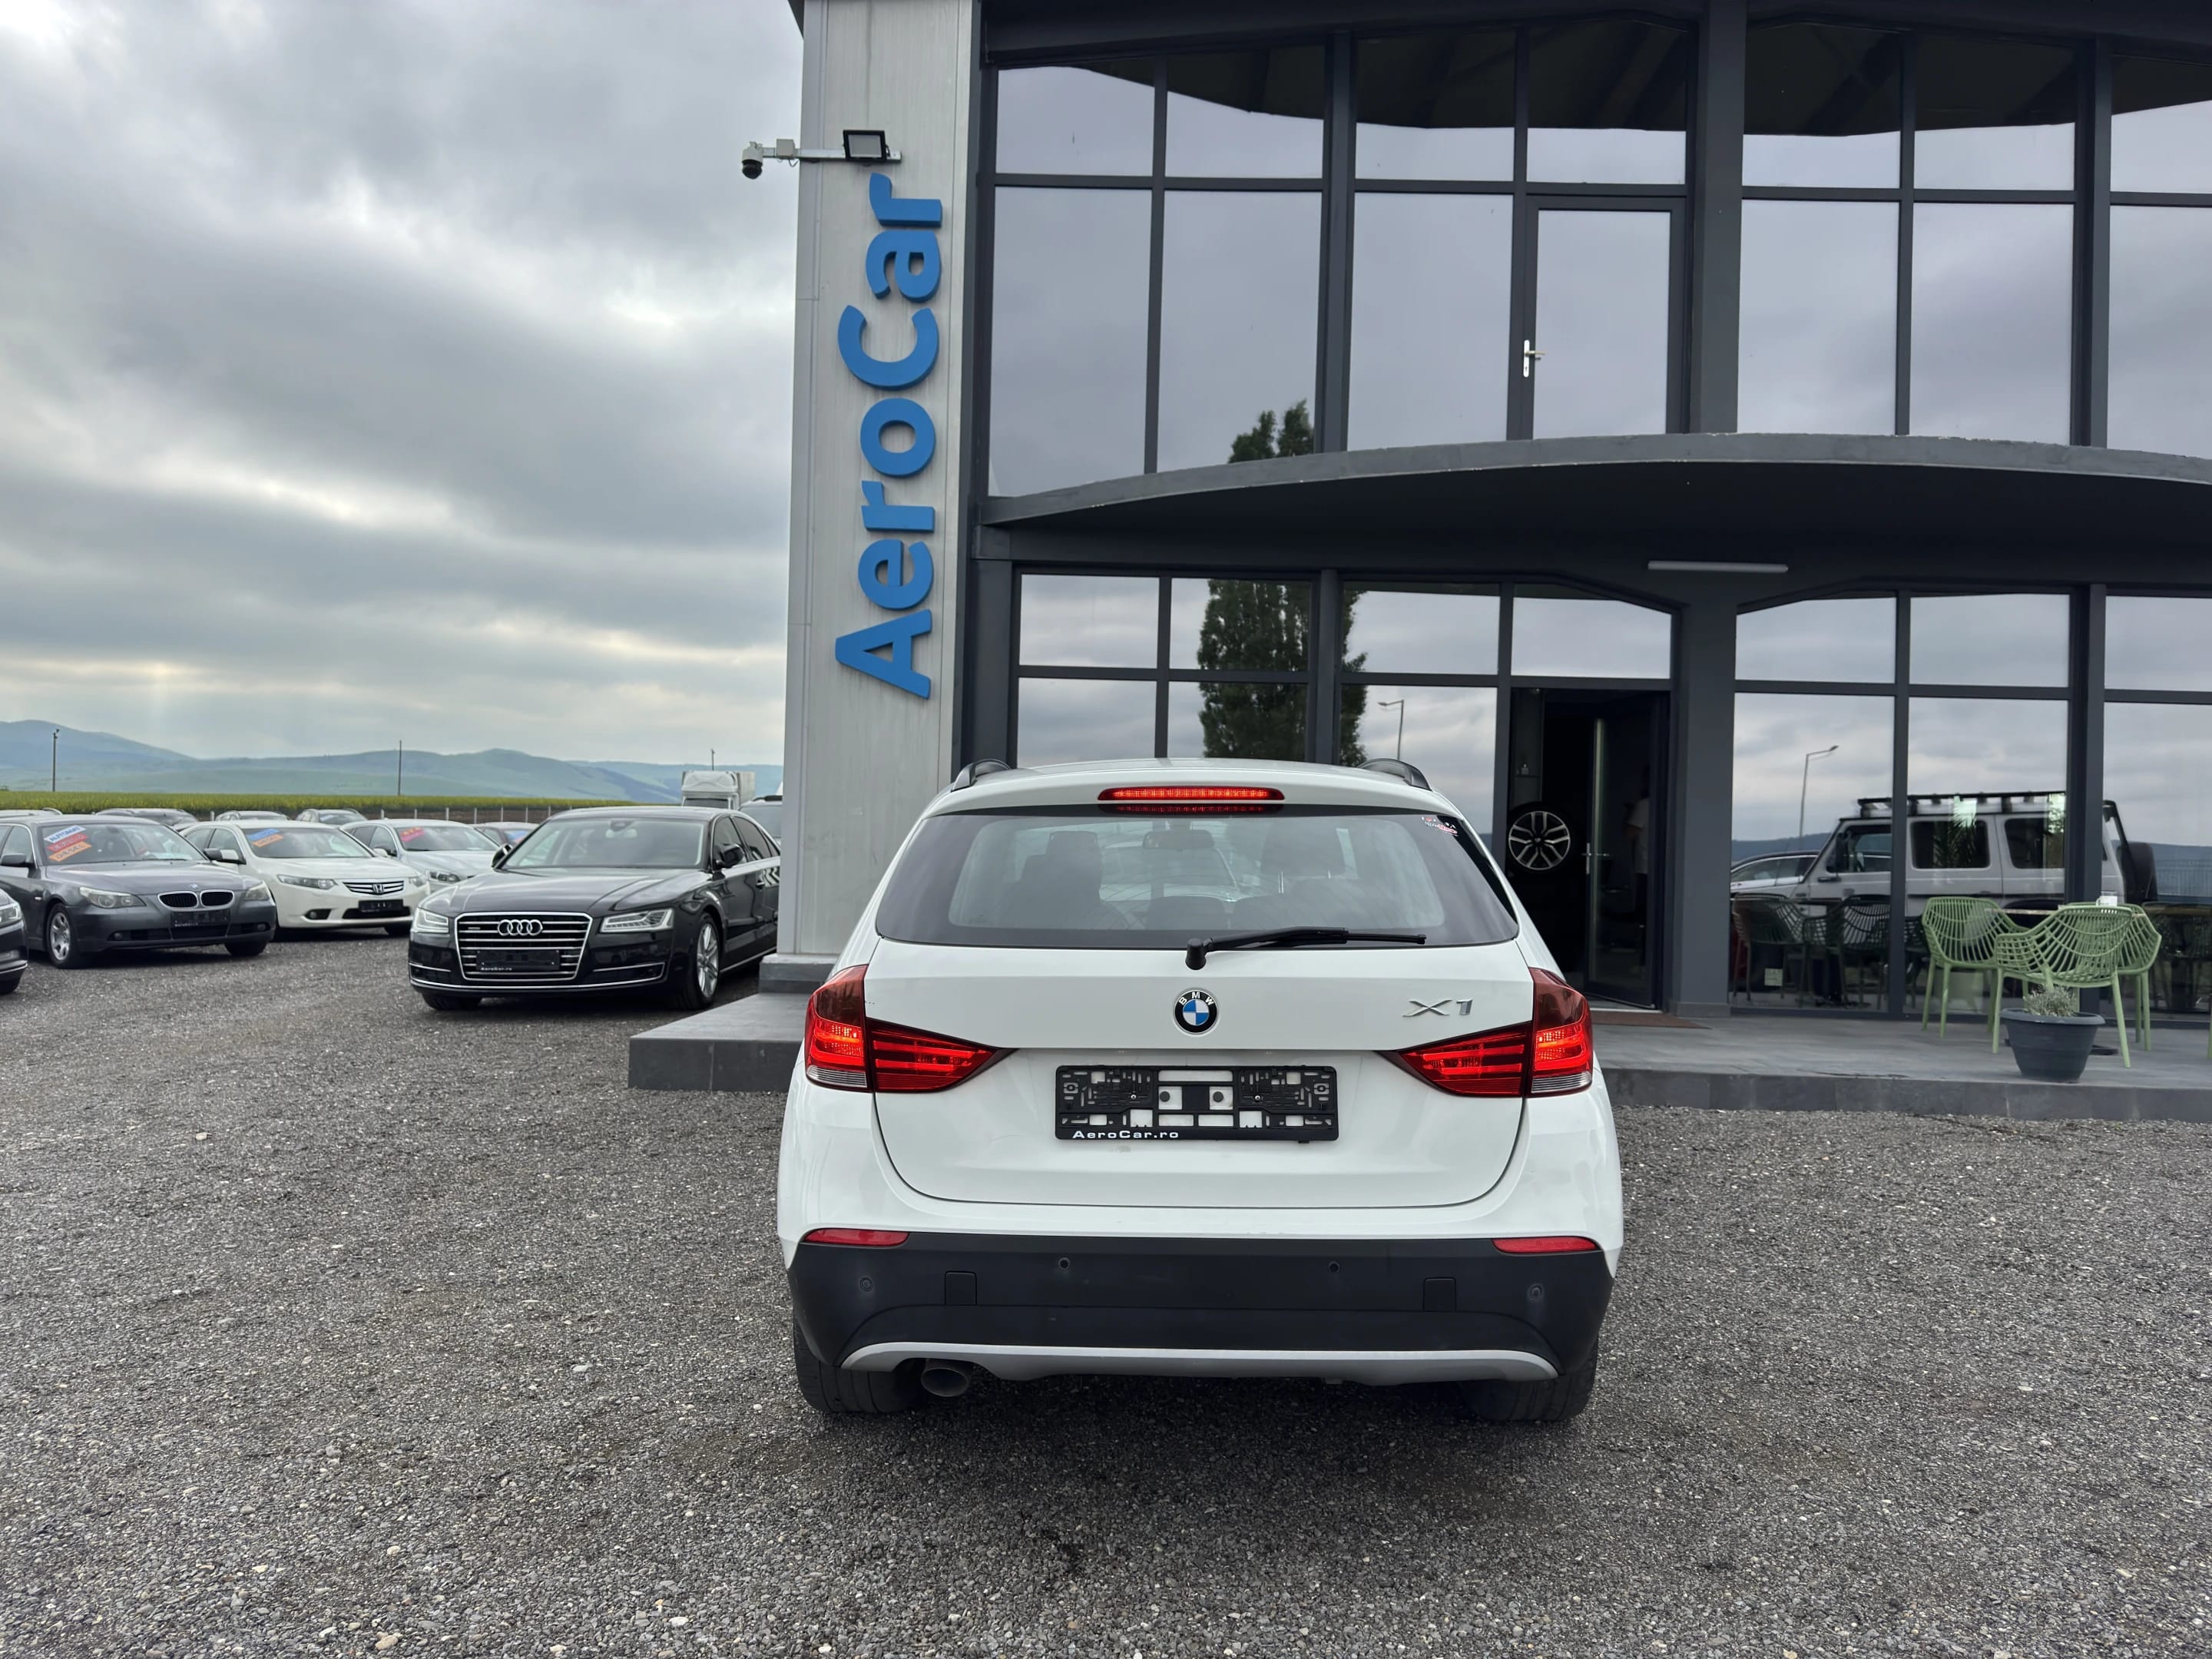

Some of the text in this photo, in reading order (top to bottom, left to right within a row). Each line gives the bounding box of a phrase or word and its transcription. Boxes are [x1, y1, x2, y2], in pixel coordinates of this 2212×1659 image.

[835, 172, 942, 700] AeroCar
[1177, 991, 1215, 1005] BMW
[1401, 998, 1474, 1018] X1
[1072, 1130, 1180, 1139] AeroCar.ro
